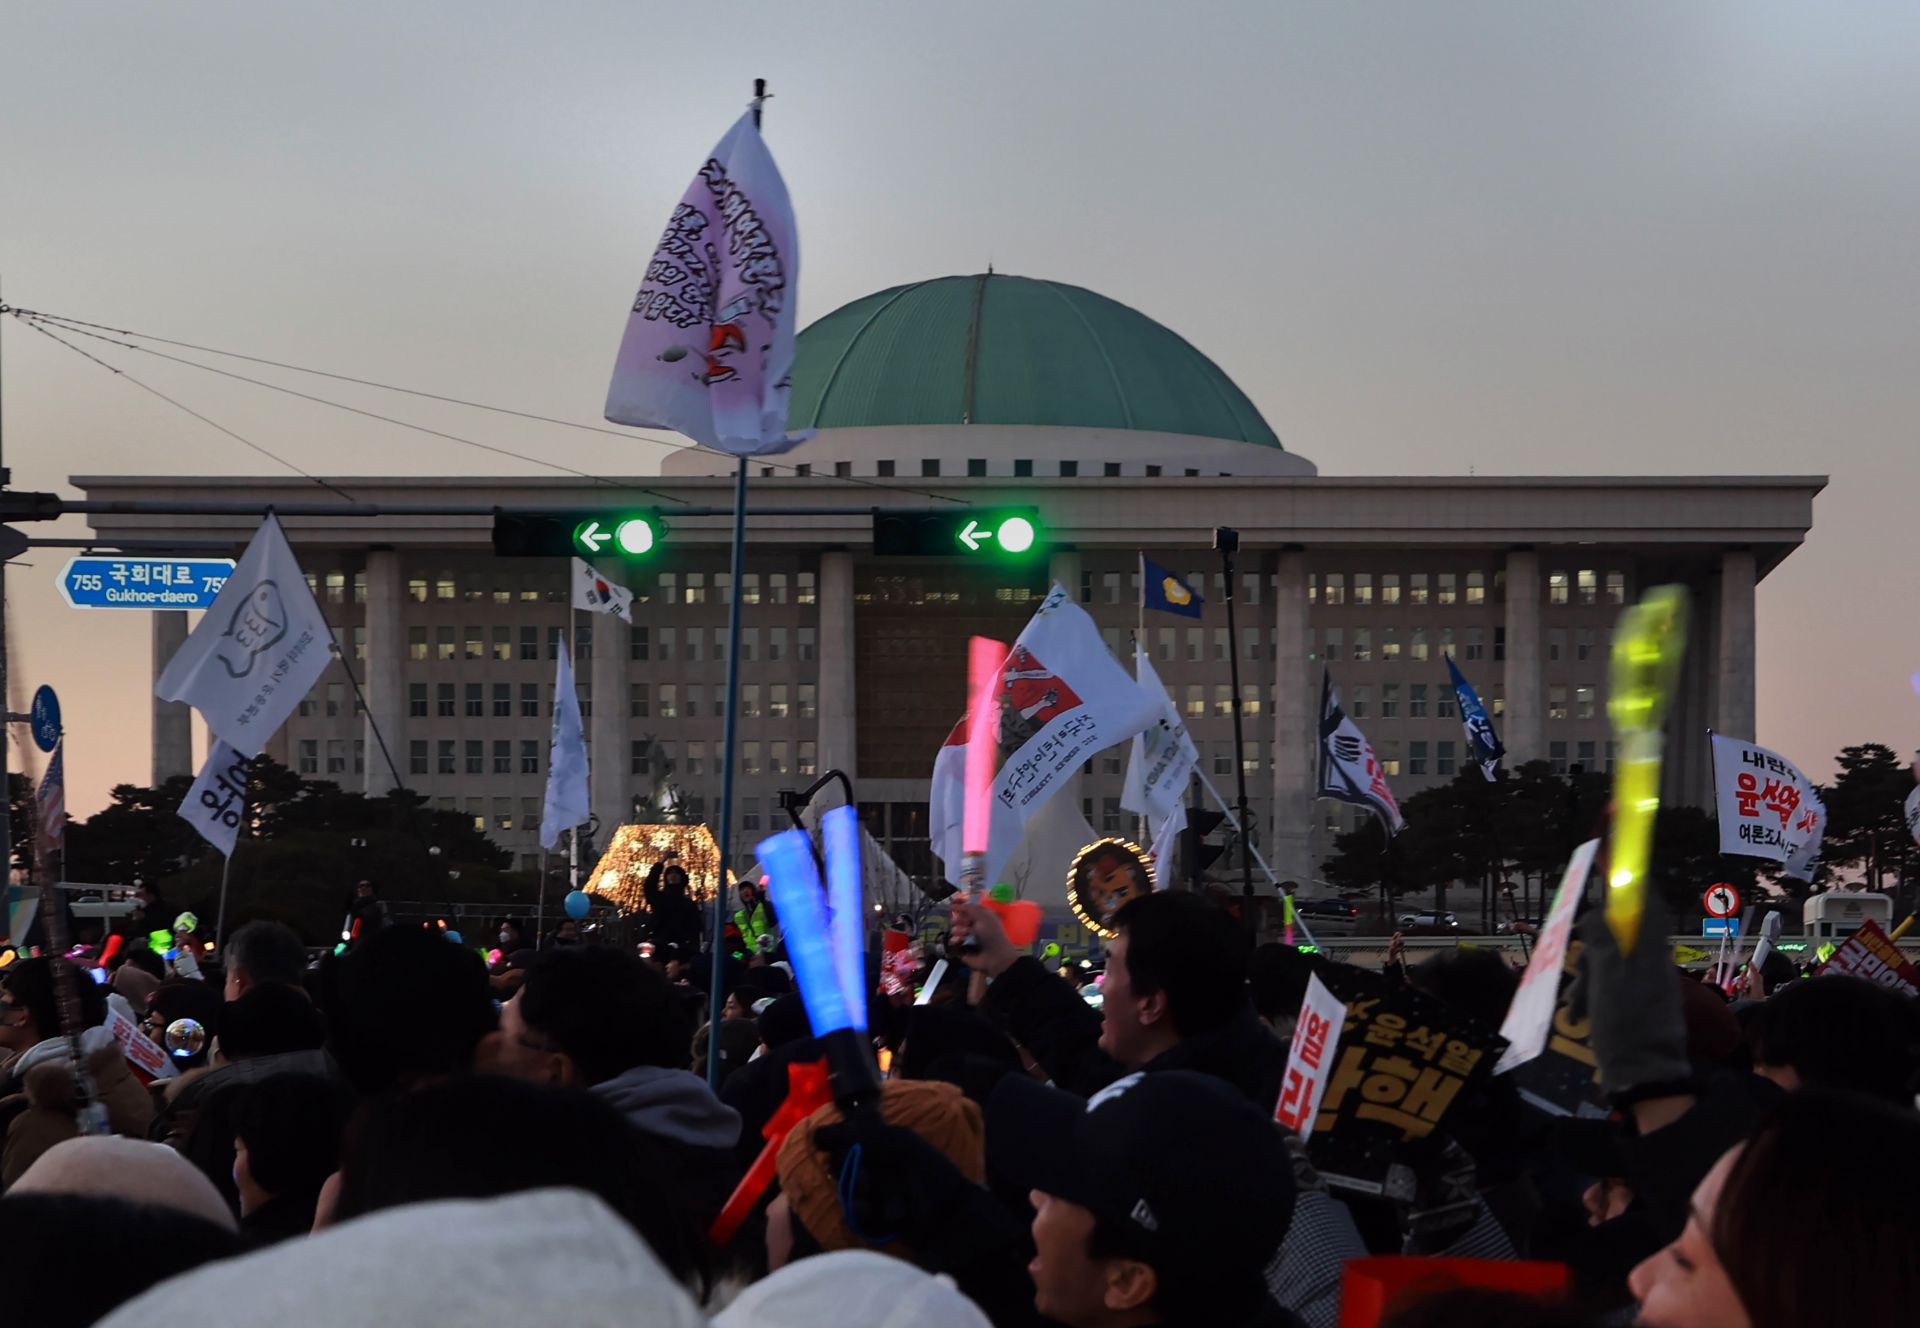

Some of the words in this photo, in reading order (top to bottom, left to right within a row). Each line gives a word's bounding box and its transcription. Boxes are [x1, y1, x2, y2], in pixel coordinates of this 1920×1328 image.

[72, 574, 102, 591] 755
[108, 563, 194, 586] 국회대로
[105, 588, 198, 603] Gukhoe-daero
[1363, 1013, 1484, 1077] 윤석열
